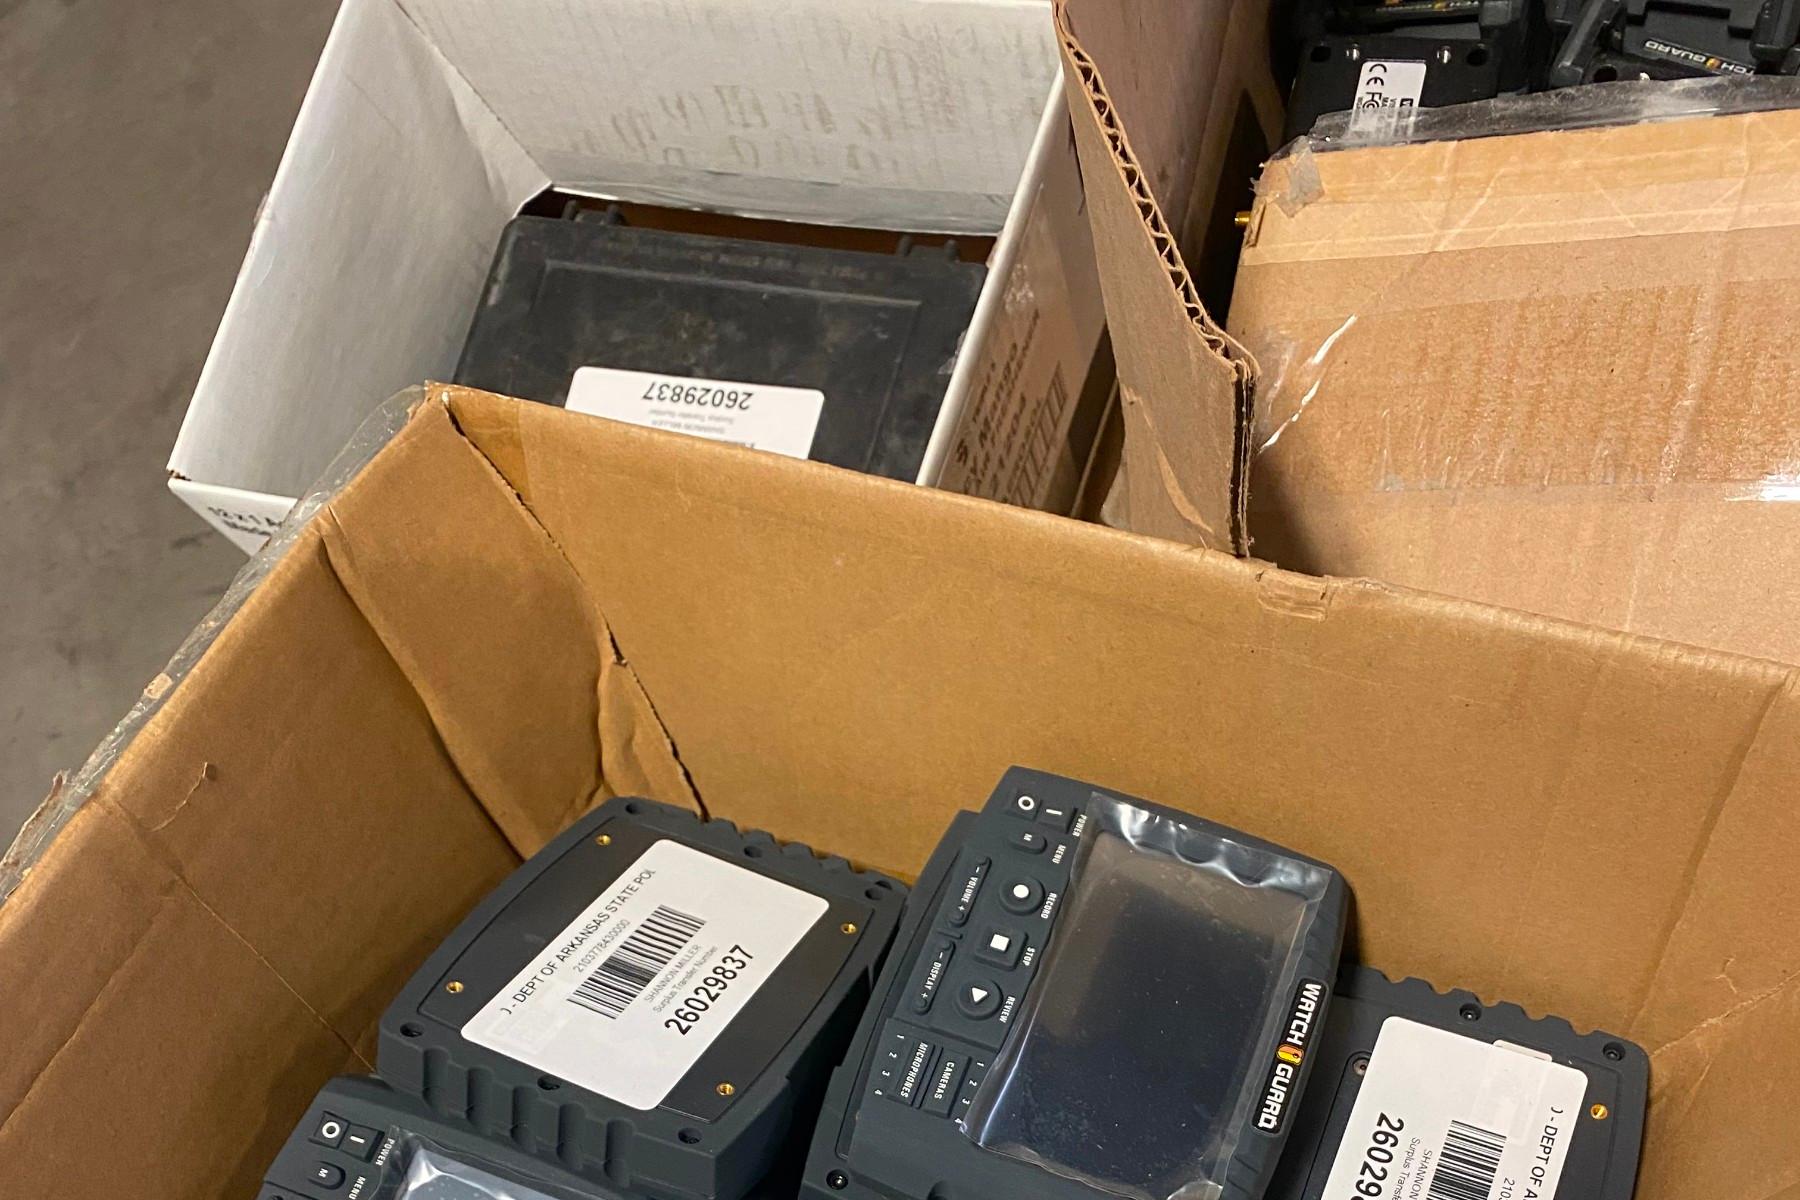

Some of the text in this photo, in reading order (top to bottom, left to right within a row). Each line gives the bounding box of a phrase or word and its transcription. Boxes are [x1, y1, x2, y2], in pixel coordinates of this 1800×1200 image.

[1644, 40, 1706, 63] GUARD
[642, 381, 755, 411] 26029837
[1072, 814, 1088, 837] POWER
[1052, 844, 1066, 864] MENU
[961, 877, 978, 903] VOLUME
[1040, 892, 1057, 919] RECORD
[513, 975, 544, 1002] DEPT
[540, 961, 557, 975] OF
[556, 912, 610, 962] ARKANSAS
[605, 880, 639, 912] STATE
[1023, 947, 1035, 966] STOP
[644, 945, 701, 1002] SHANNON MILLER
[652, 946, 717, 1012] Surplus Transfer Number
[925, 962, 941, 990] DISPLAY
[664, 944, 753, 1035] 26029837
[999, 996, 1015, 1023] REVIEW
[900, 1042, 928, 1097] MICROPHONES
[1257, 983, 1322, 1130] WATCH GUARD
[934, 1062, 954, 1099] CAMERAS
[375, 1138, 395, 1165] POWER
[1403, 1137, 1420, 1168] Surplus
[1536, 1125, 1558, 1164] DEPT
[318, 1168, 328, 1177] M
[1409, 1150, 1432, 1200] SHANNON
[1529, 1166, 1545, 1187] OF
[349, 1176, 366, 1200] MENU
